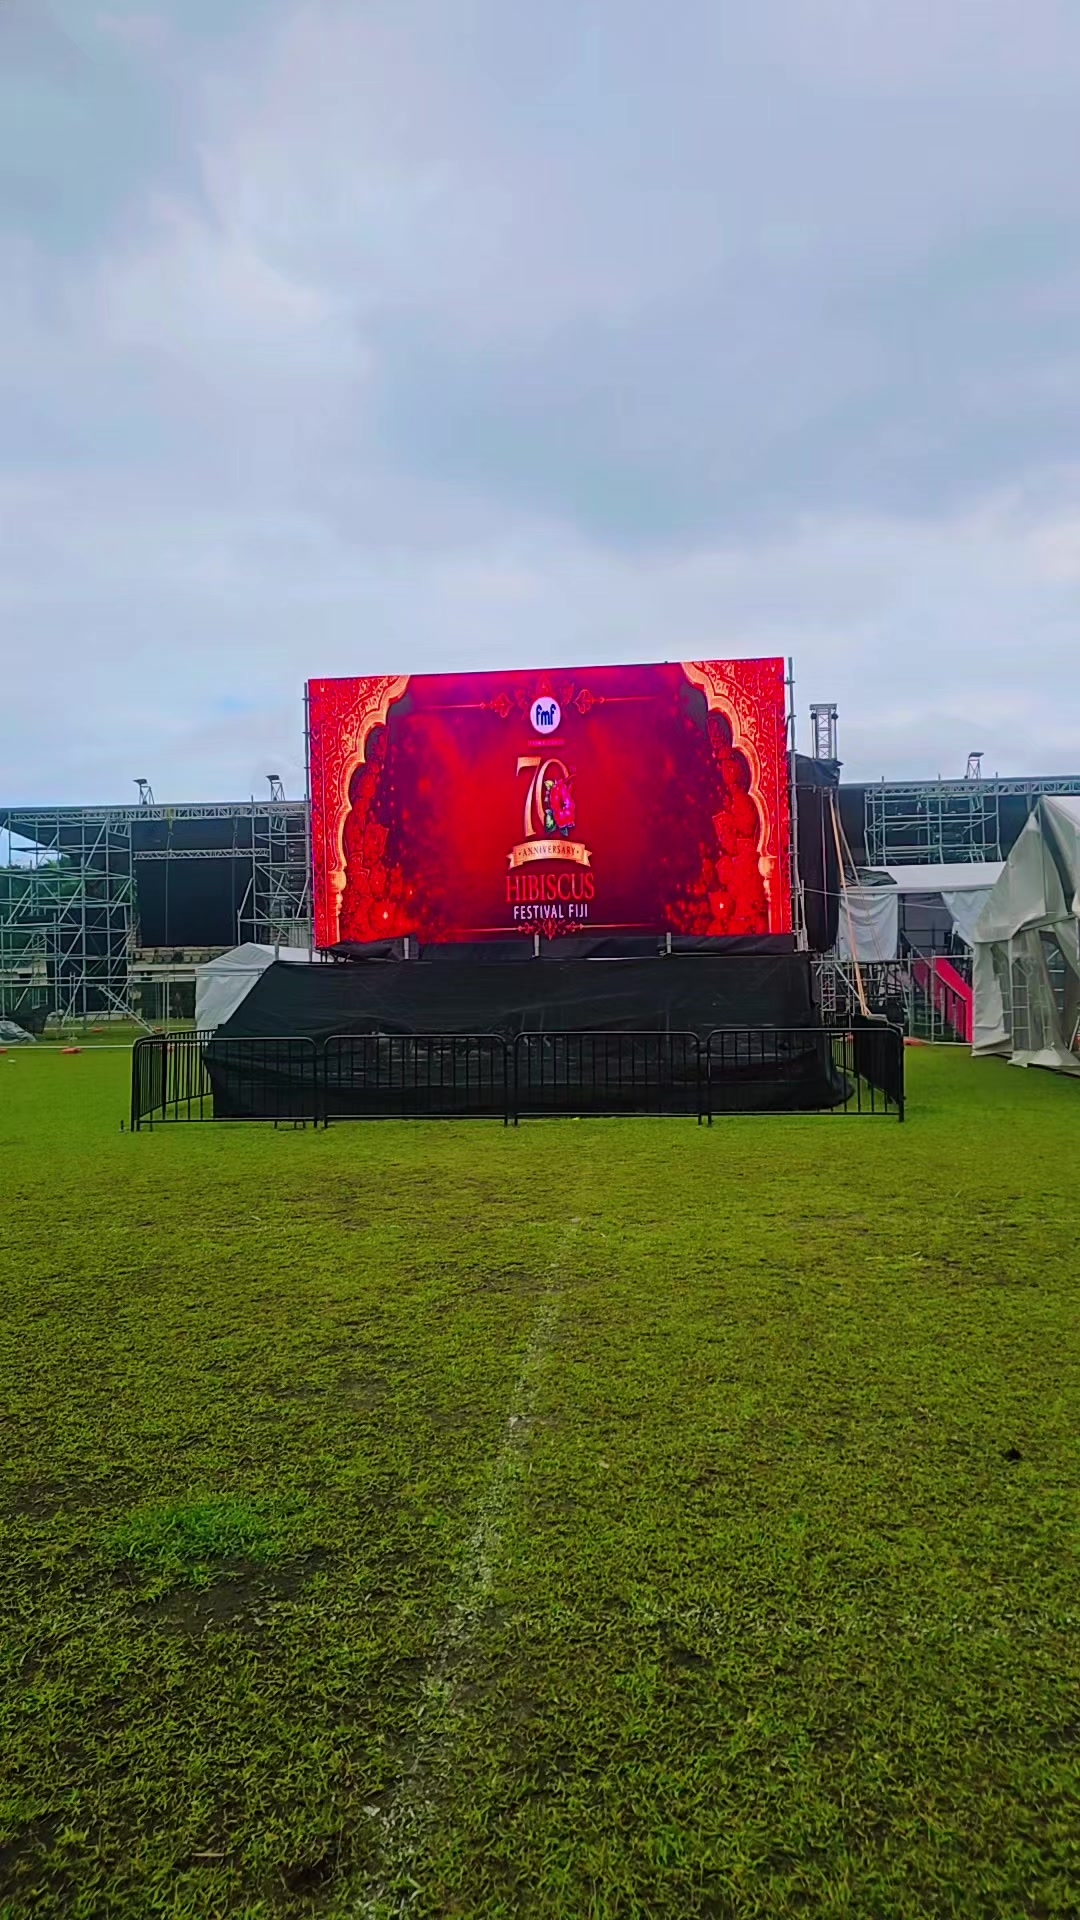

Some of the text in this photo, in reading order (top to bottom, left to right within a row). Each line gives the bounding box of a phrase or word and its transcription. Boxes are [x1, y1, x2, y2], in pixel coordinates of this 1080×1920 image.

[536, 703, 557, 726] fmf
[522, 845, 576, 857] ANNIVERSARY
[505, 873, 595, 902] HIBISCUS
[513, 903, 588, 920] FESTIVAL FIJI
